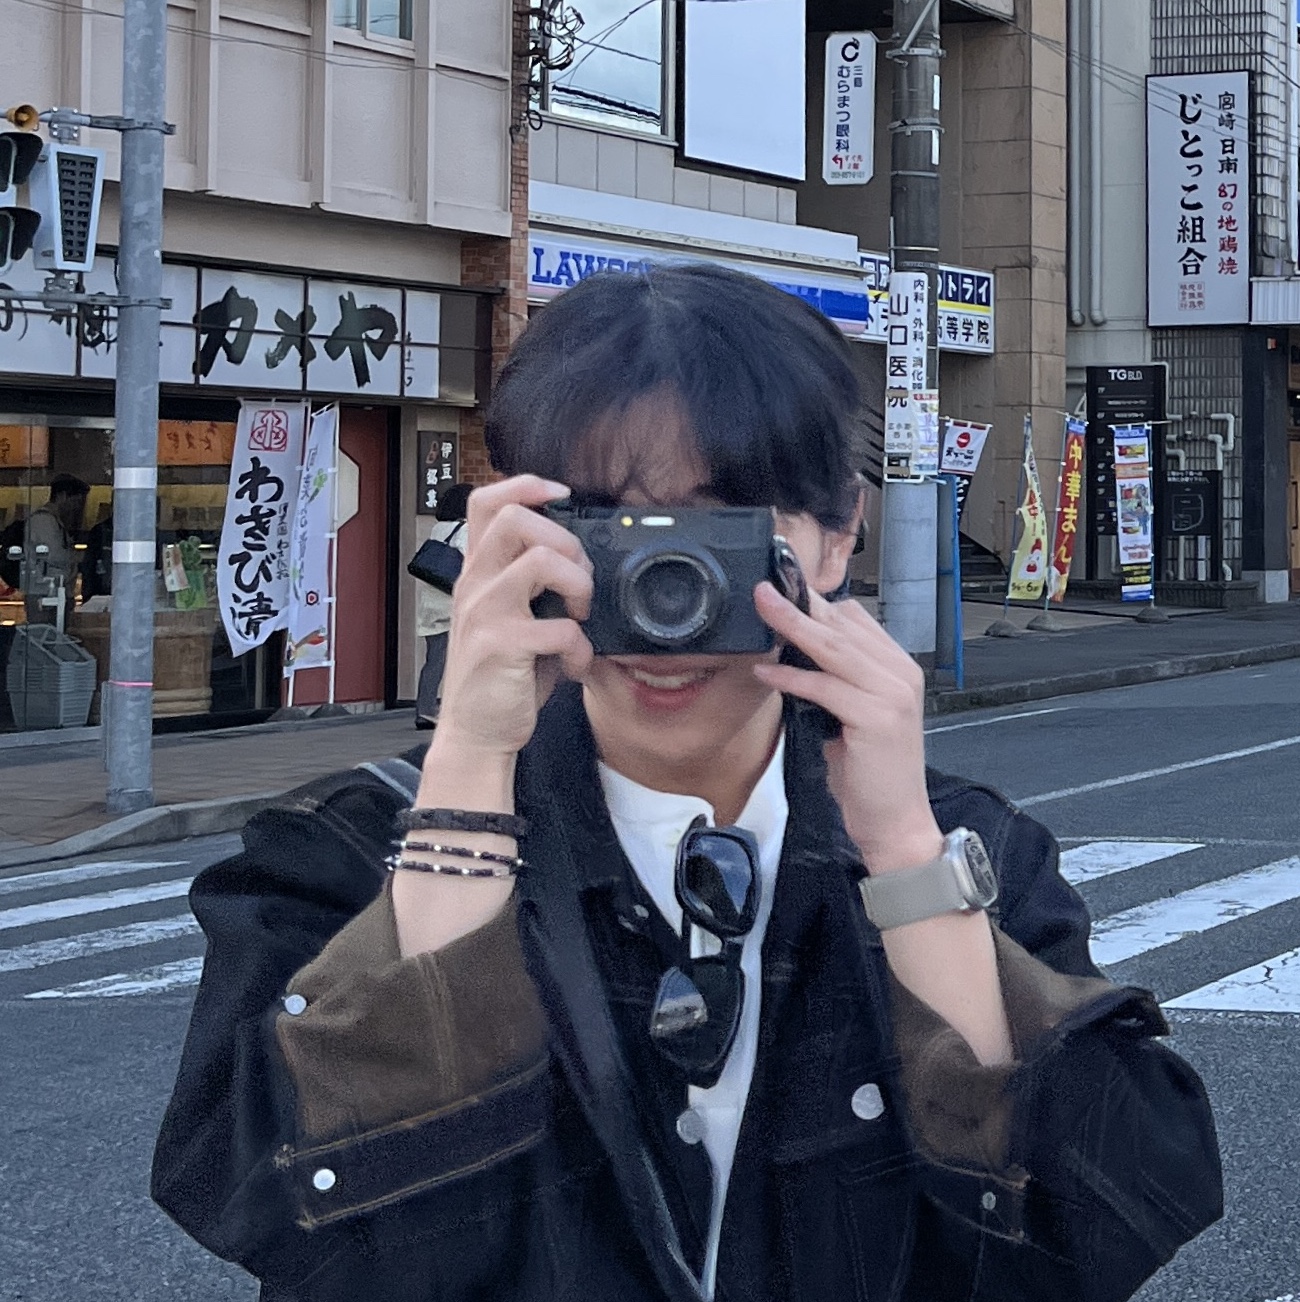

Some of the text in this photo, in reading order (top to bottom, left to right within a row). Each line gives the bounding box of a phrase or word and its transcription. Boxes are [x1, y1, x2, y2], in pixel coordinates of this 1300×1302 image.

[835, 65, 850, 152] むらまつ眼科
[1218, 137, 1238, 174] 日南
[1177, 94, 1207, 275] じとっこ組合
[889, 293, 909, 408] 山口医院
[1108, 369, 1127, 380] TG
[1055, 438, 1083, 563] 中華まん
